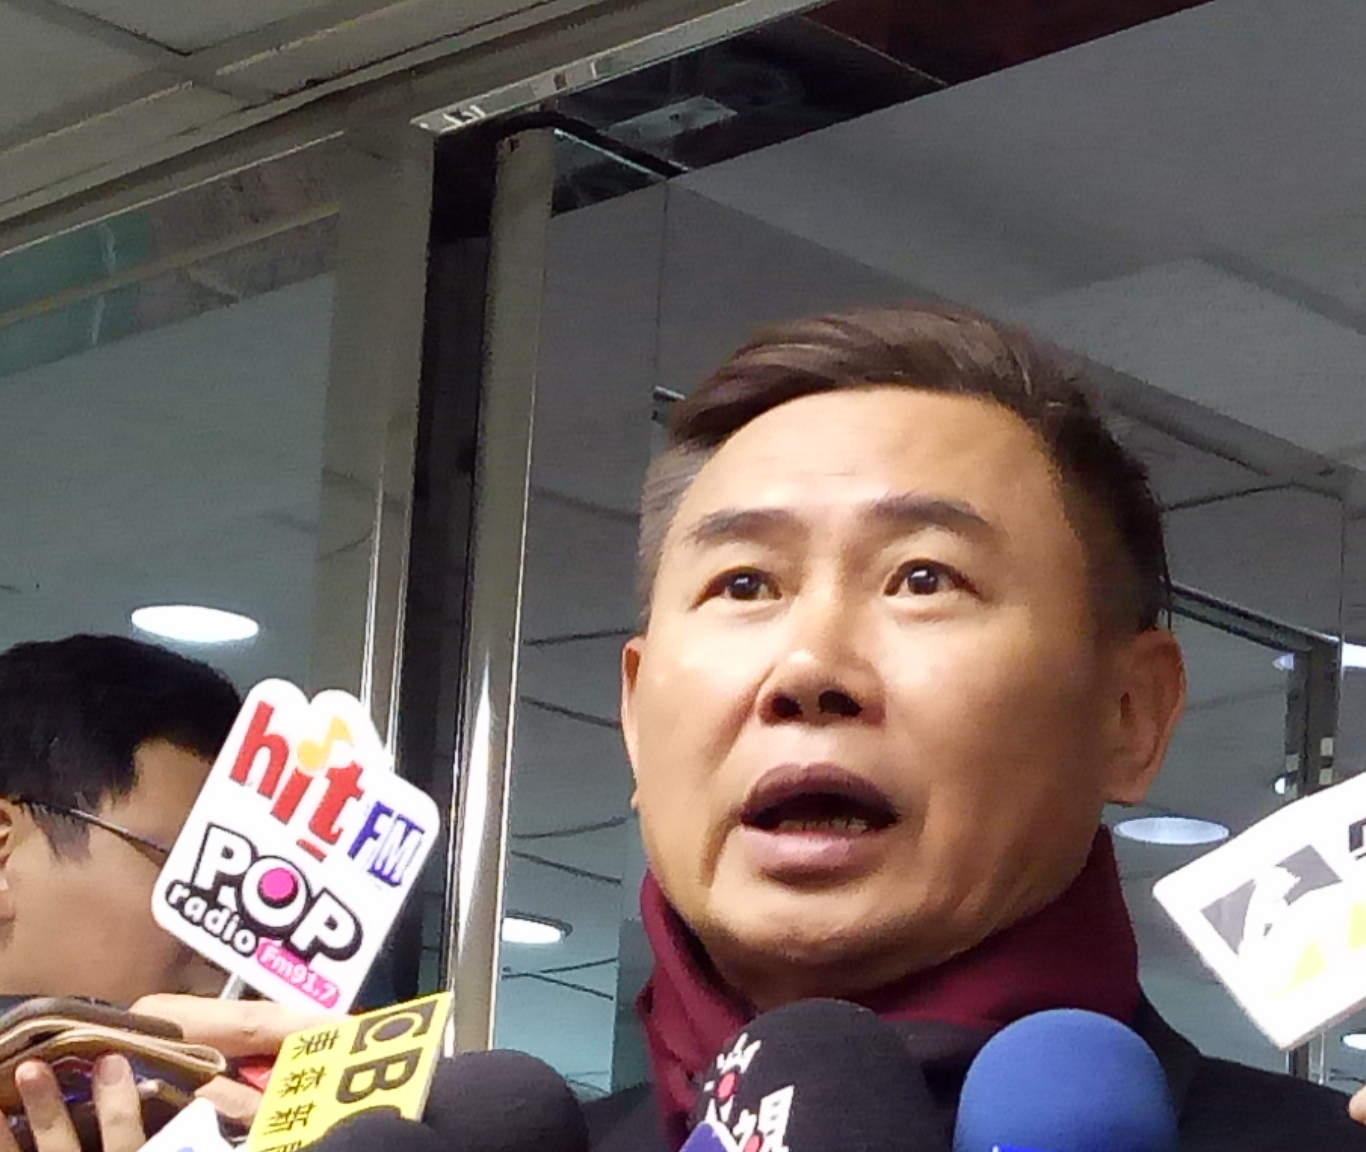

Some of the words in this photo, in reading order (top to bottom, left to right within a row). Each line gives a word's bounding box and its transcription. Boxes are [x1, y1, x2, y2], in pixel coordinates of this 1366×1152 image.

[229, 700, 365, 846] hit
[347, 800, 426, 887] FM
[165, 880, 257, 958] radio
[191, 822, 364, 961] POP
